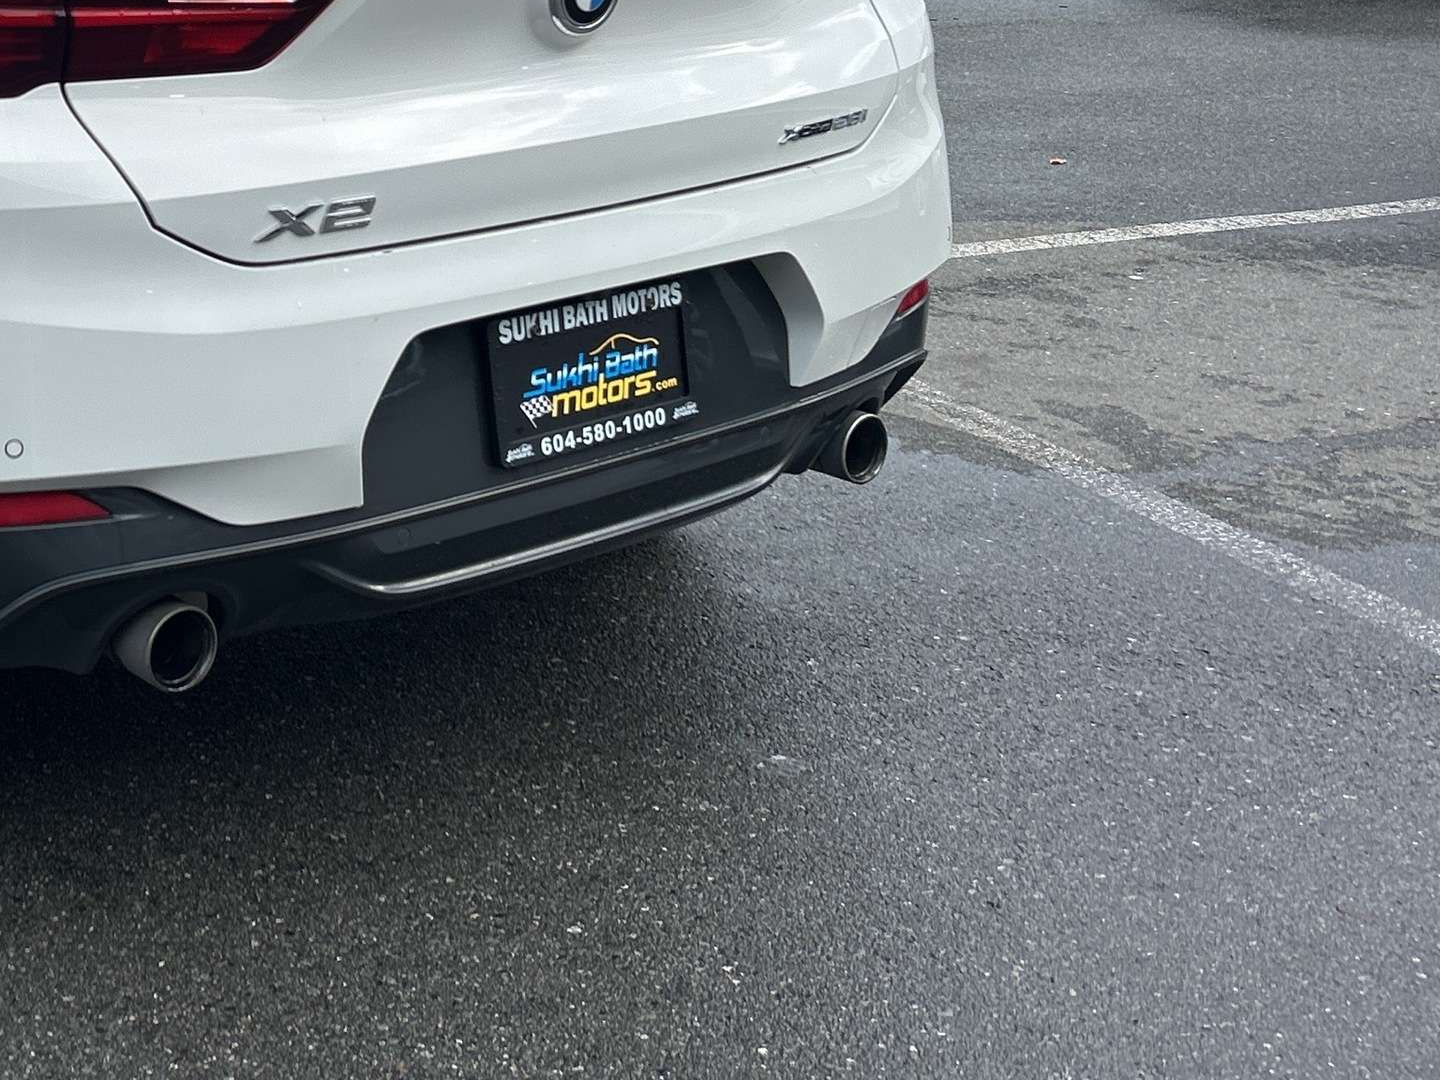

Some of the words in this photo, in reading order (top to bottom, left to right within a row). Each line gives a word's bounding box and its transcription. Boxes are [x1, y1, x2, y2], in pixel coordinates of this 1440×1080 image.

[253, 195, 377, 244] X2
[498, 308, 561, 345] SUKHI
[562, 299, 609, 331] BATH
[611, 281, 682, 319] MOTORS
[523, 352, 600, 398] Sukhi
[605, 344, 659, 379] Bath
[540, 407, 667, 456] 604-580-1000
